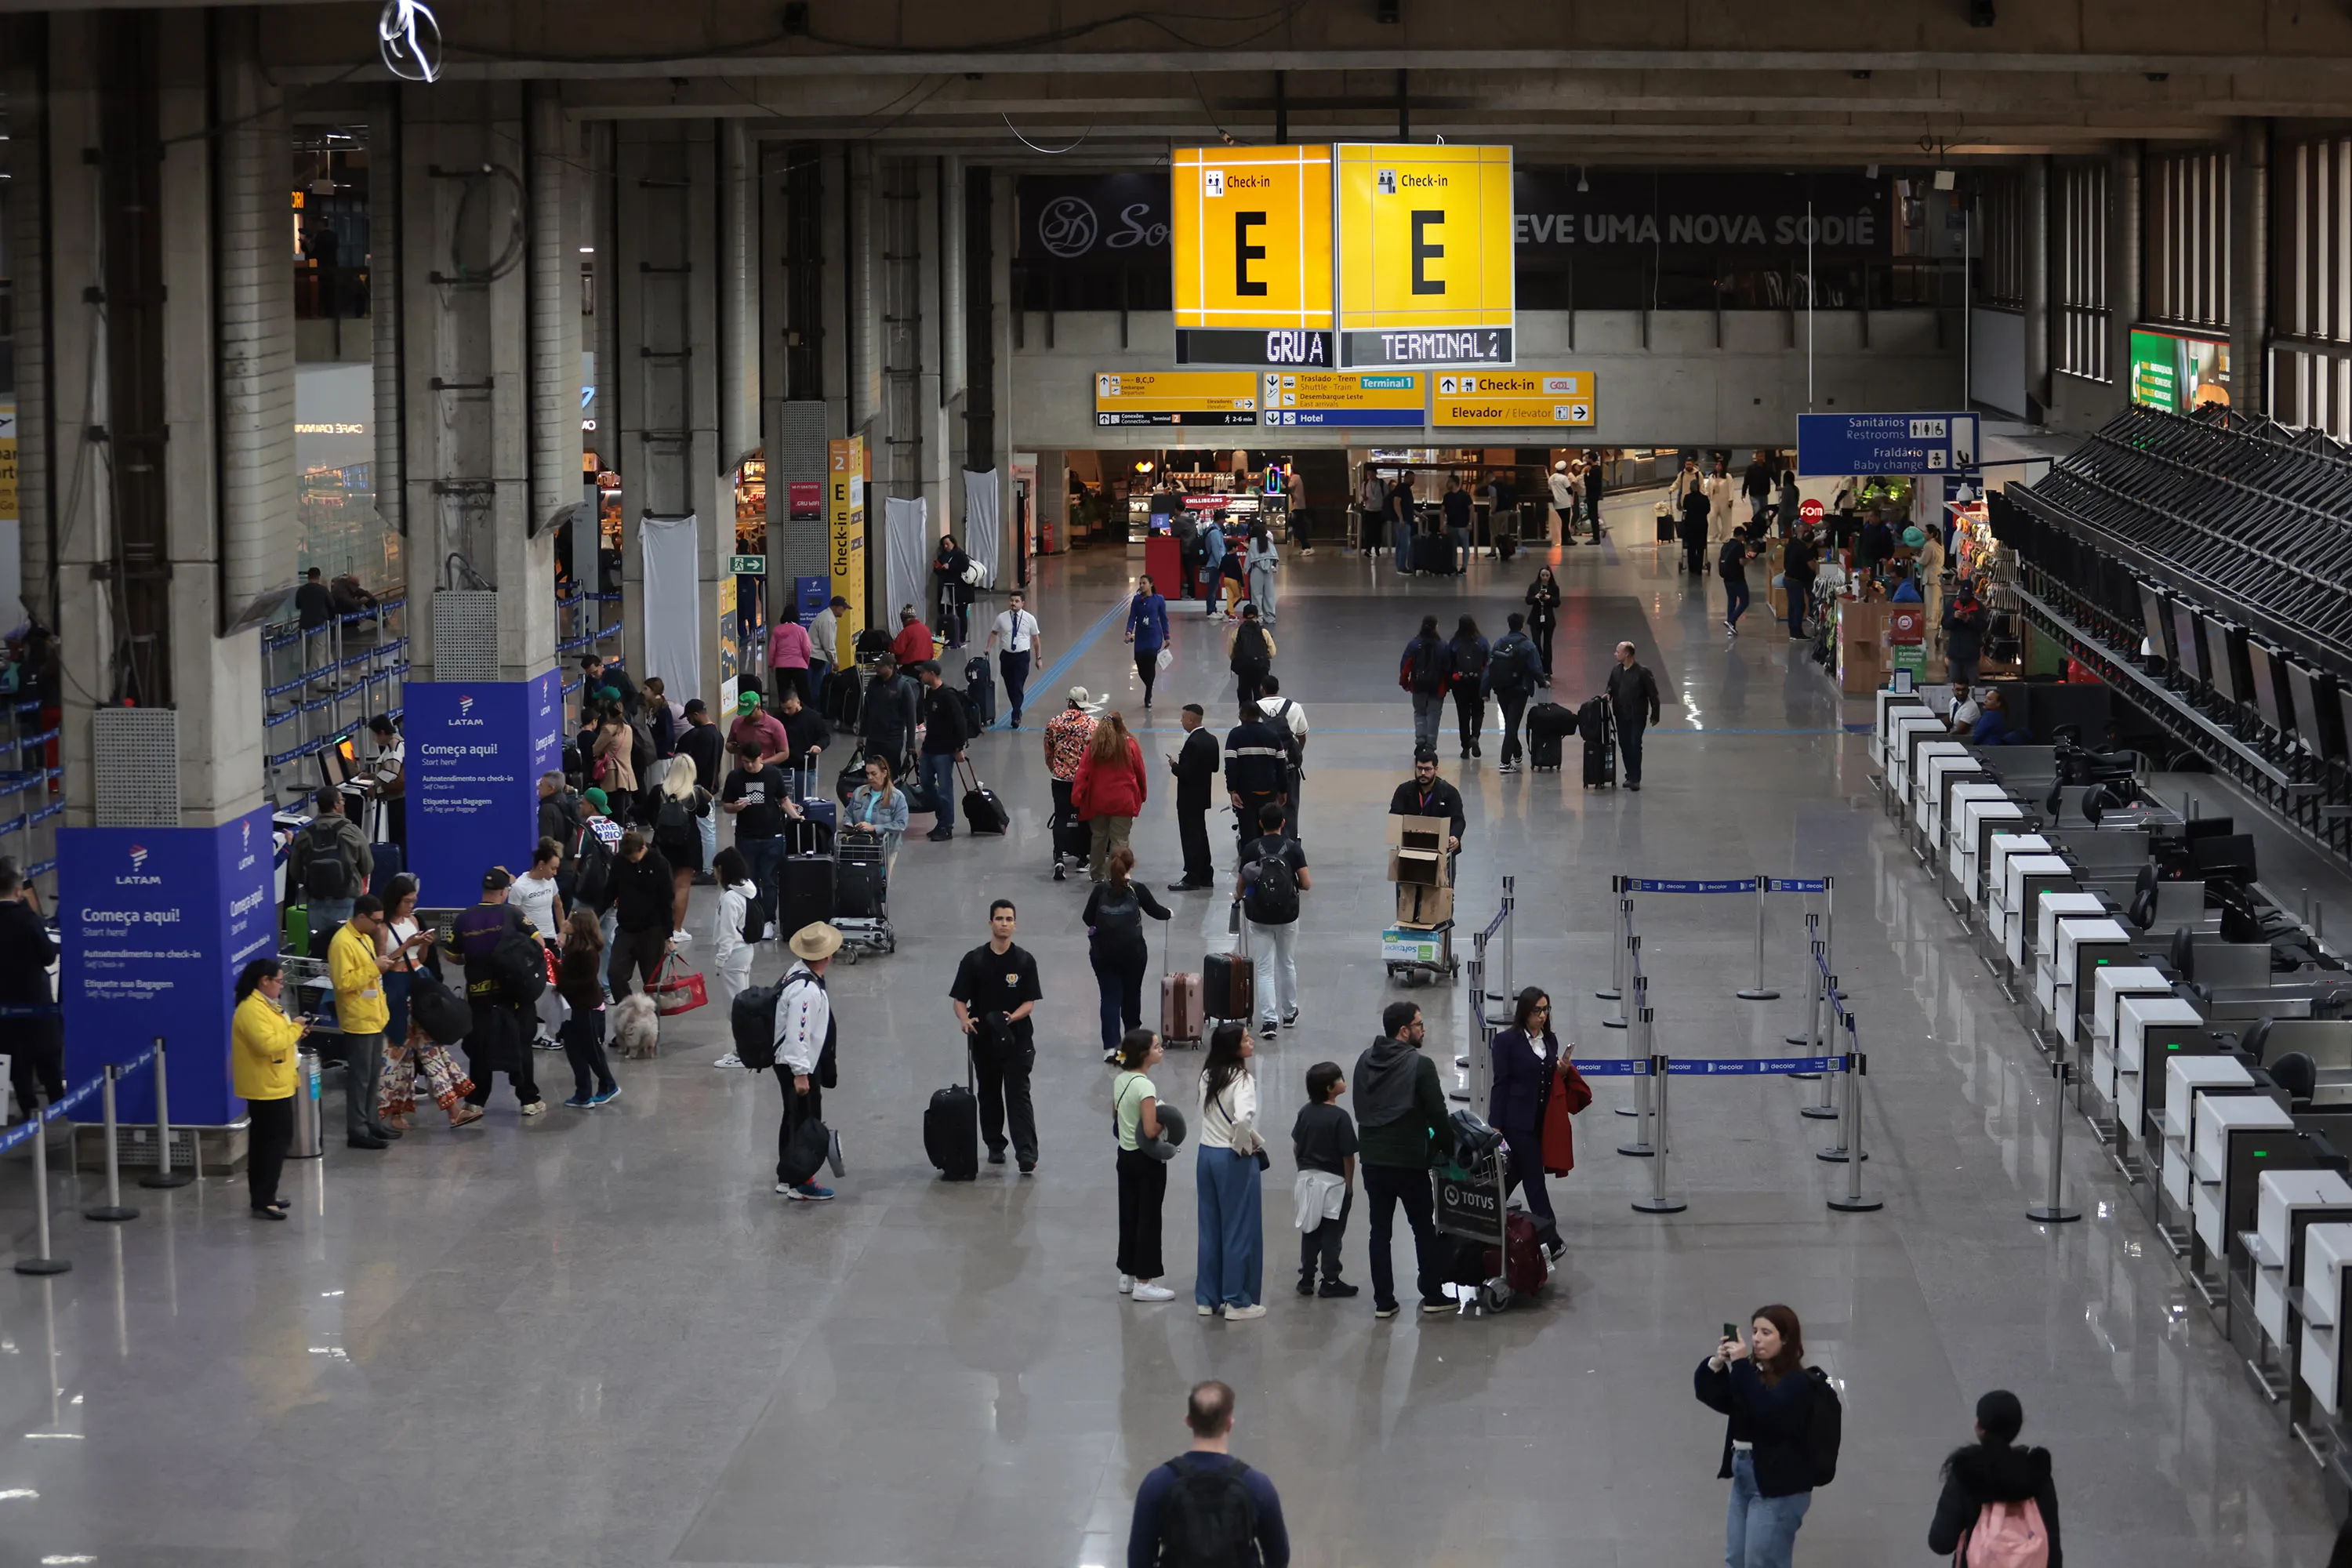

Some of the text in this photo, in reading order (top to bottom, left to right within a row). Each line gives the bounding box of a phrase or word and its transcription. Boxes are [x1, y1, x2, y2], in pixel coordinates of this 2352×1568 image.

[1227, 176, 1270, 188] Check-in
[1401, 174, 1448, 187] Check-in
[1584, 214, 1661, 244] UMA
[1669, 214, 1766, 245] NOVA
[1774, 207, 1875, 245] SODIÊ
[1236, 211, 1268, 296] E
[1411, 210, 1445, 296] E
[1267, 331, 1305, 363] GRU
[1381, 332, 1484, 361] TERMINAL
[1363, 378, 1411, 387] Terminal 1
[1479, 379, 1534, 390] Check-in
[1301, 414, 1323, 423] Hotel
[1452, 407, 1503, 418] Elevador
[1512, 408, 1551, 418] Elevator
[1849, 417, 1905, 427] Sanitários
[1847, 430, 1905, 440] Restrooms
[1874, 448, 1923, 457] Fraldário
[835, 456, 844, 470] 2
[1854, 460, 1923, 472] Baby change
[835, 484, 844, 500] E
[834, 512, 847, 576] Check-in
[421, 743, 498, 757] Começa aqui!
[463, 798, 492, 807] Bagagem
[604, 831, 621, 840] RIO
[115, 876, 162, 884] LATAM
[82, 908, 180, 926] Começa aqui!
[82, 927, 128, 937] Start here!
[83, 949, 153, 958] Autoatendimento
[85, 979, 118, 989] Etiquete
[136, 980, 173, 990] Bagagem
[1461, 1192, 1494, 1210] TOTVS
